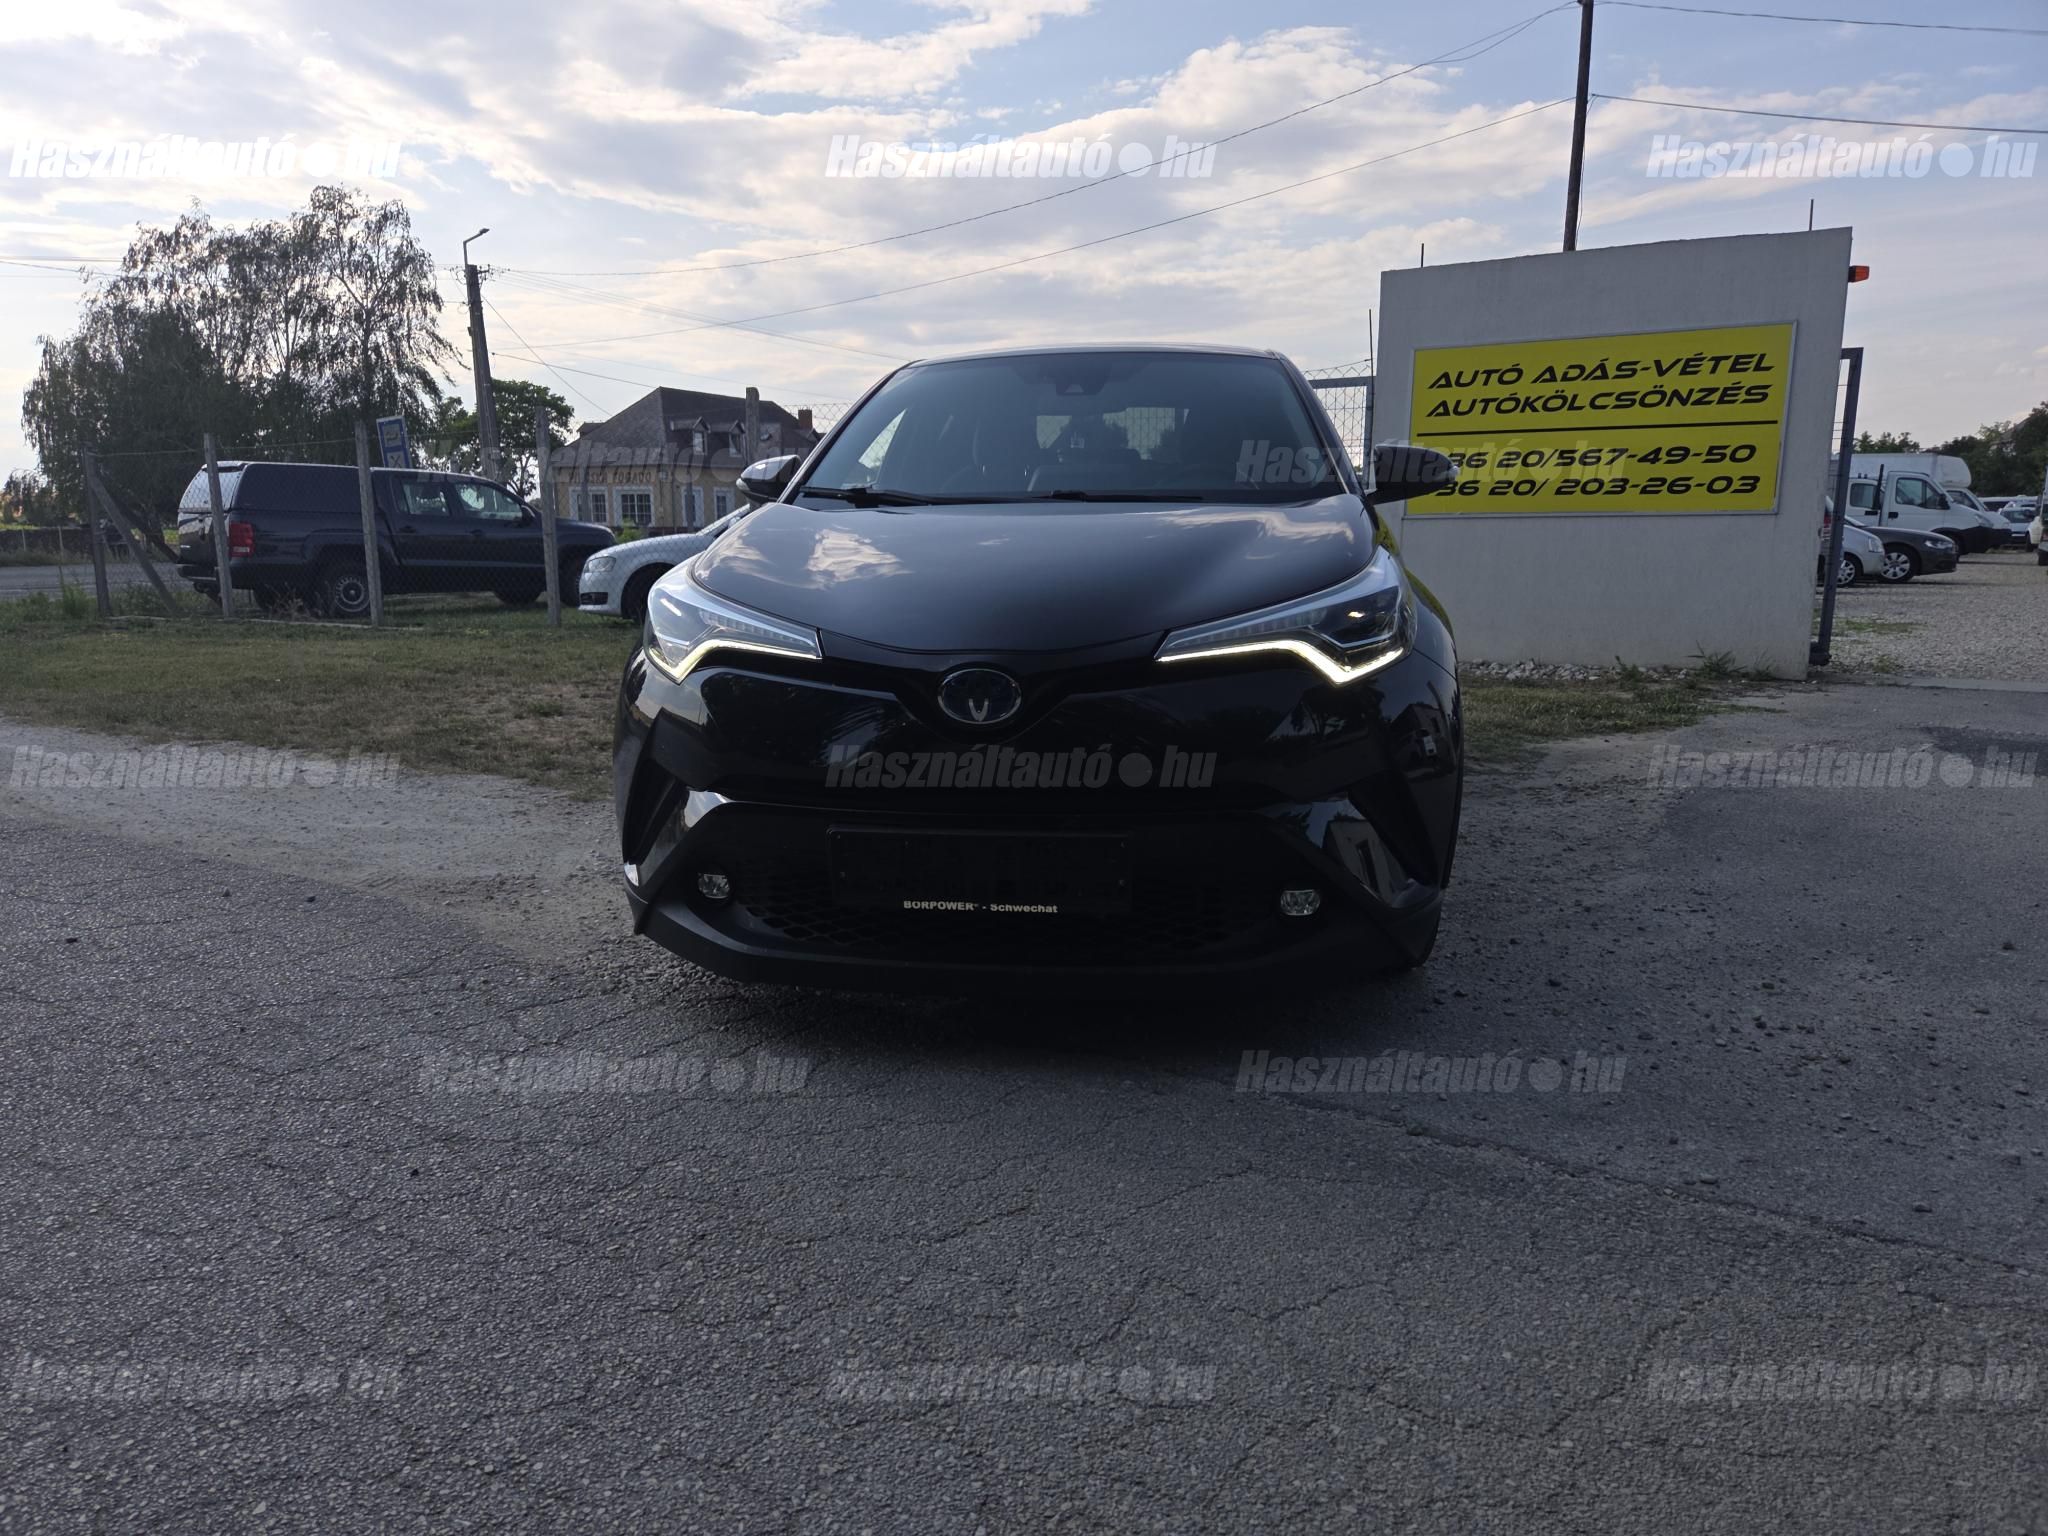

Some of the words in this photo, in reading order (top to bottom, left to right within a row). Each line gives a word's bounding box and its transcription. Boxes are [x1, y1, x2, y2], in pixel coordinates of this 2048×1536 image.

[1428, 364, 1524, 389] AUTÓ
[1531, 352, 1775, 384] ADÁS-VÉTEL
[1425, 381, 1773, 417] AUTÓKÖLCSÖNZÉS
[1496, 445, 1757, 468] 20/567-49-50
[1488, 479, 1549, 496] 20/
[1555, 475, 1760, 496] 203-26-03
[990, 903, 1058, 913] Schwechat
